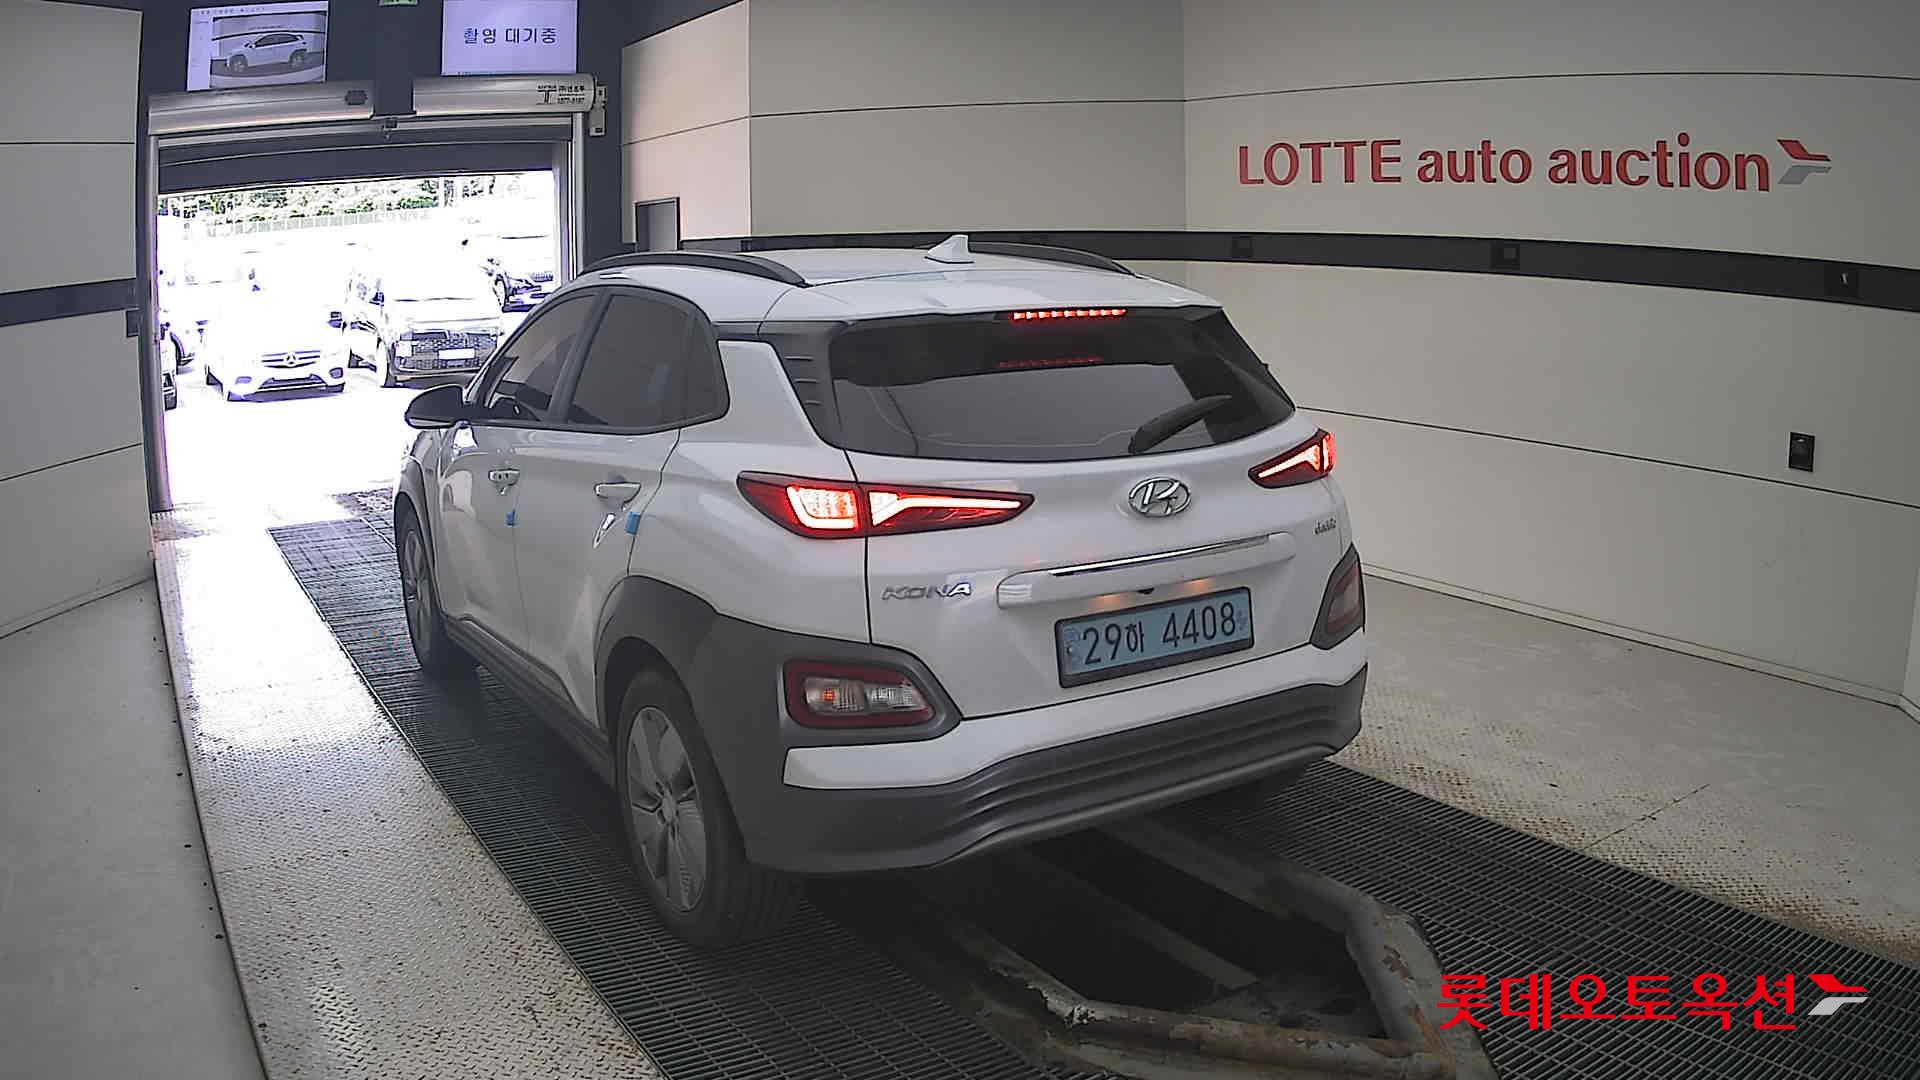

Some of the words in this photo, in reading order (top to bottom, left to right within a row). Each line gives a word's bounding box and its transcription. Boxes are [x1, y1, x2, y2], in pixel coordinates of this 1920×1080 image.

[463, 27, 496, 44] 촬영
[505, 27, 558, 44] 대기중
[1239, 140, 1403, 185] LOTTE
[1417, 140, 1533, 185] auto
[1548, 132, 1771, 193] auction
[881, 581, 973, 601] KONA
[1082, 621, 1146, 666] 29하
[1161, 601, 1237, 648] 4408
